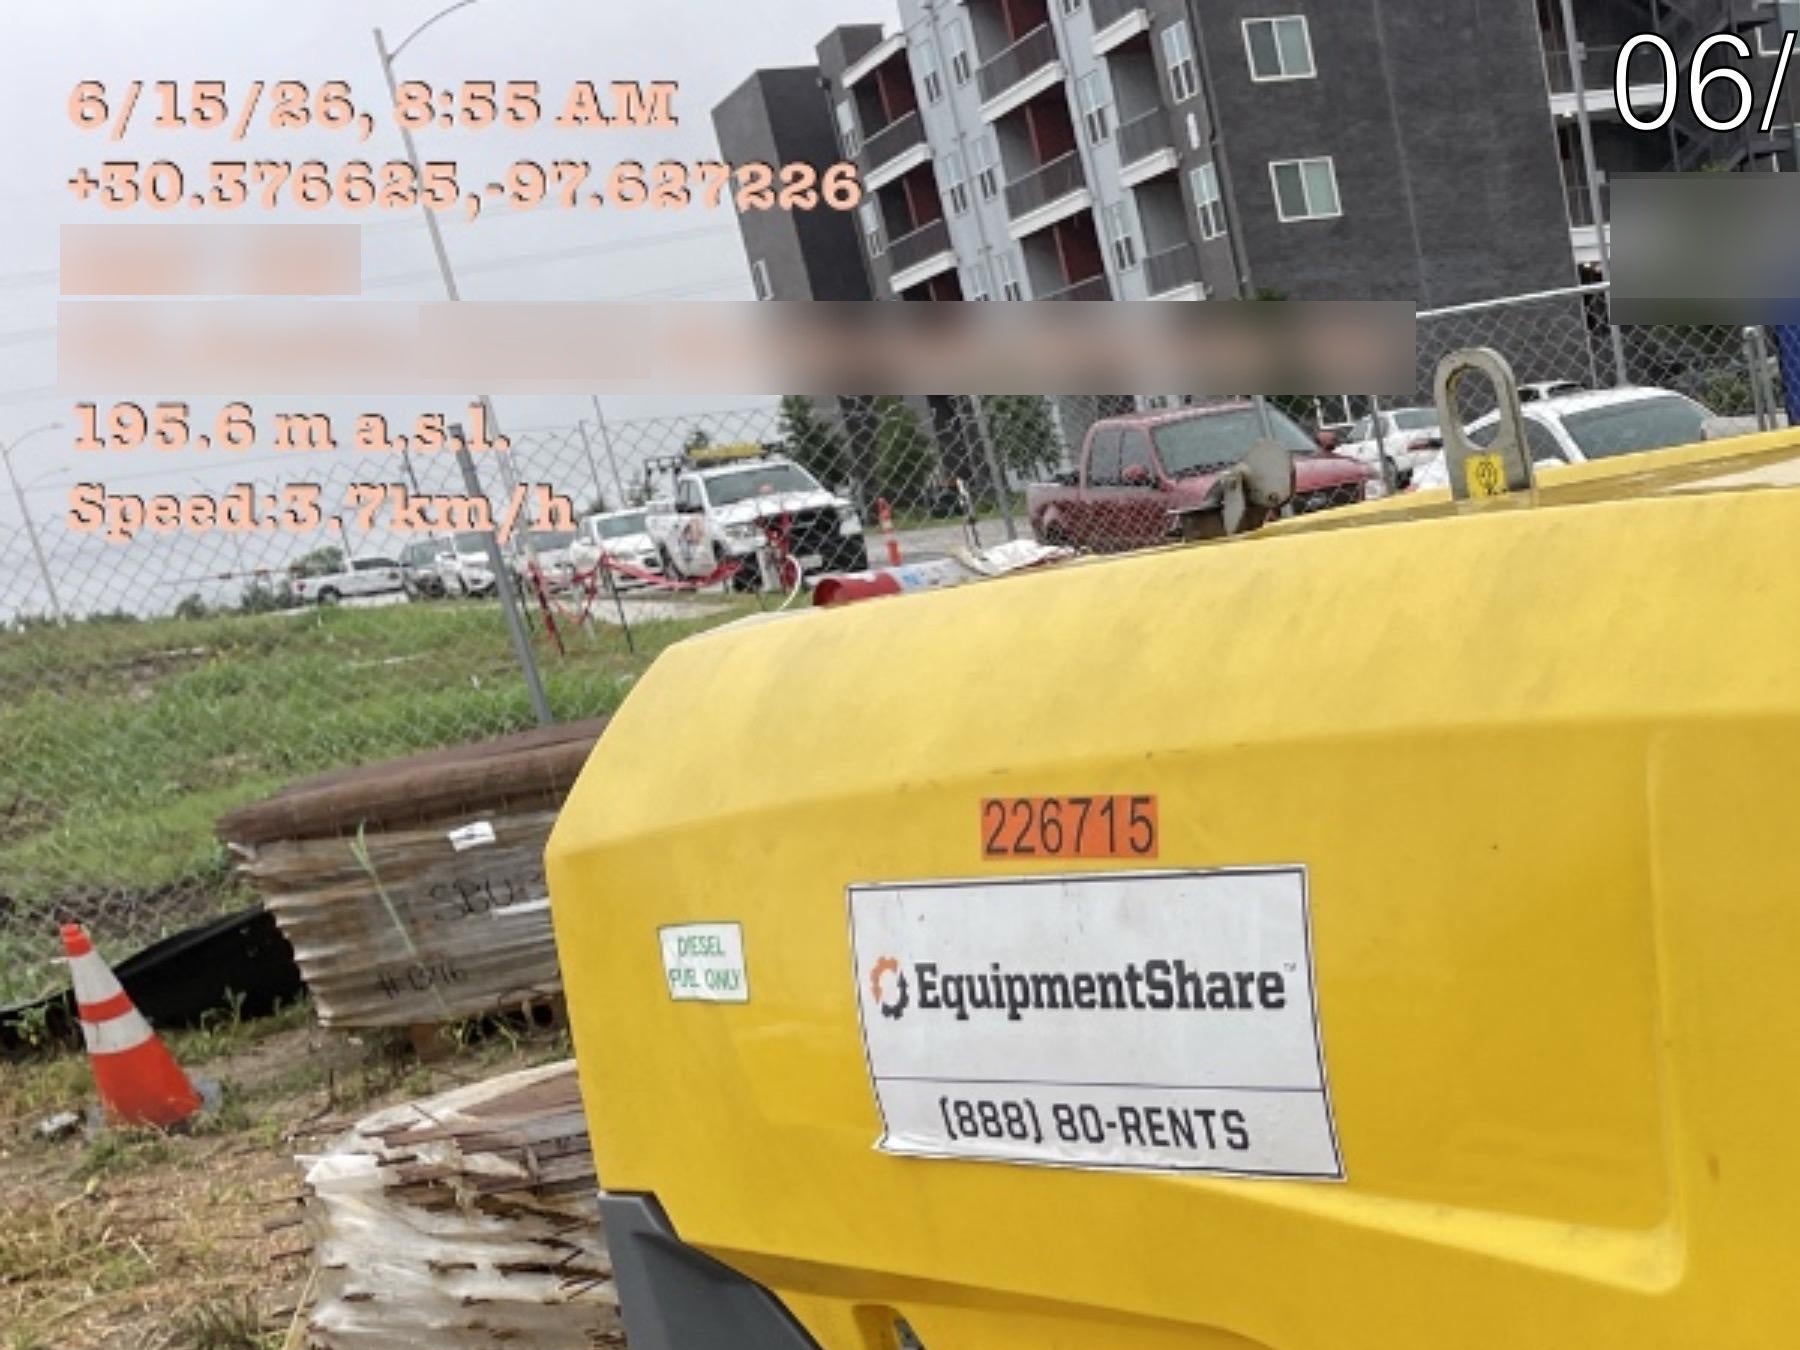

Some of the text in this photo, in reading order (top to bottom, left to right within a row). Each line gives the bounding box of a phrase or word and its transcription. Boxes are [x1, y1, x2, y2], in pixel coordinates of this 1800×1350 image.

[983, 795, 1155, 854] 226715
[677, 935, 726, 957] DIESEL
[669, 967, 742, 990] FUEL ONLY
[914, 959, 1286, 1020] EquipmentShare
[939, 1096, 1251, 1151] (888) 80-RENTS
